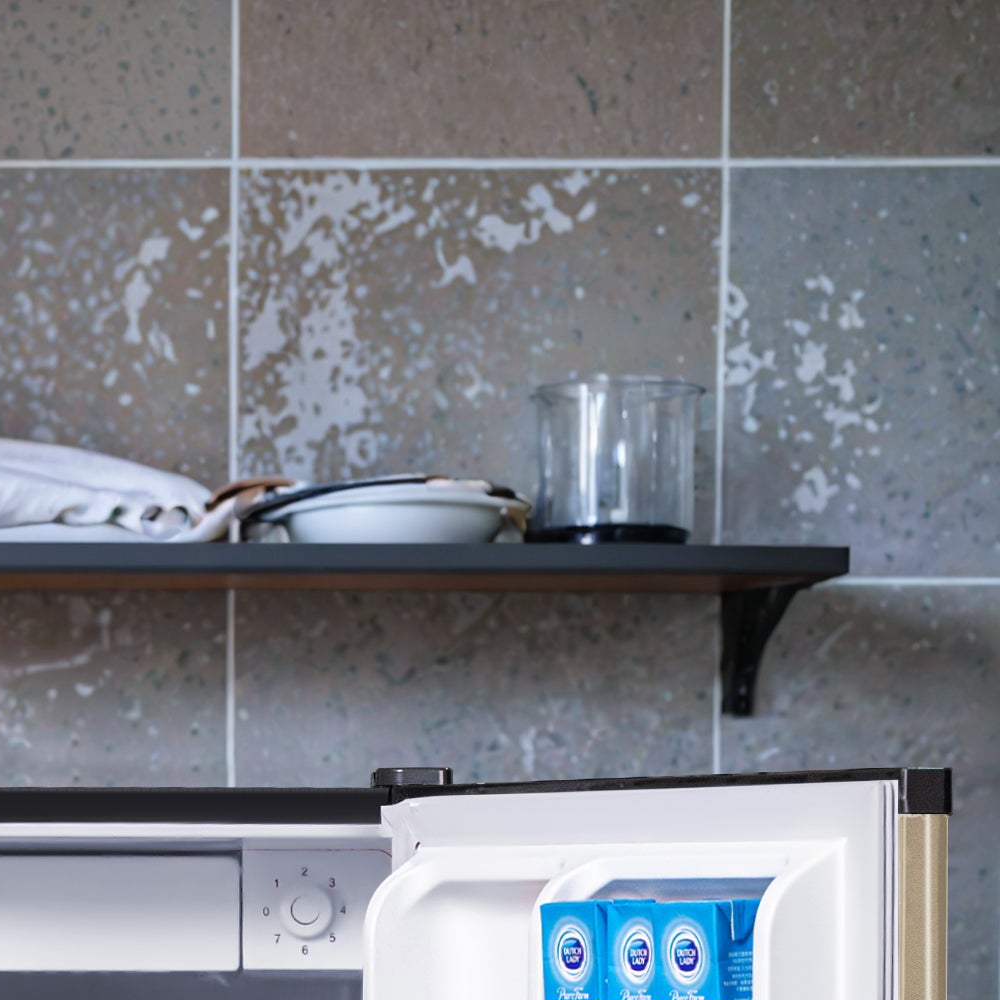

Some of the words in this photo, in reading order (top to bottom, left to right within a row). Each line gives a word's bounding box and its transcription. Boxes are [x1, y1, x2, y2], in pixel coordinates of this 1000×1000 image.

[301, 867, 308, 876] 2
[274, 878, 279, 888] 1
[329, 877, 336, 888] 3
[262, 906, 270, 917] 0
[340, 904, 346, 915] 4
[274, 933, 281, 944] 7
[329, 933, 336, 943] 5
[301, 945, 309, 955] 6
[676, 948, 696, 957] DUTCH
[678, 956, 694, 965] LADY
